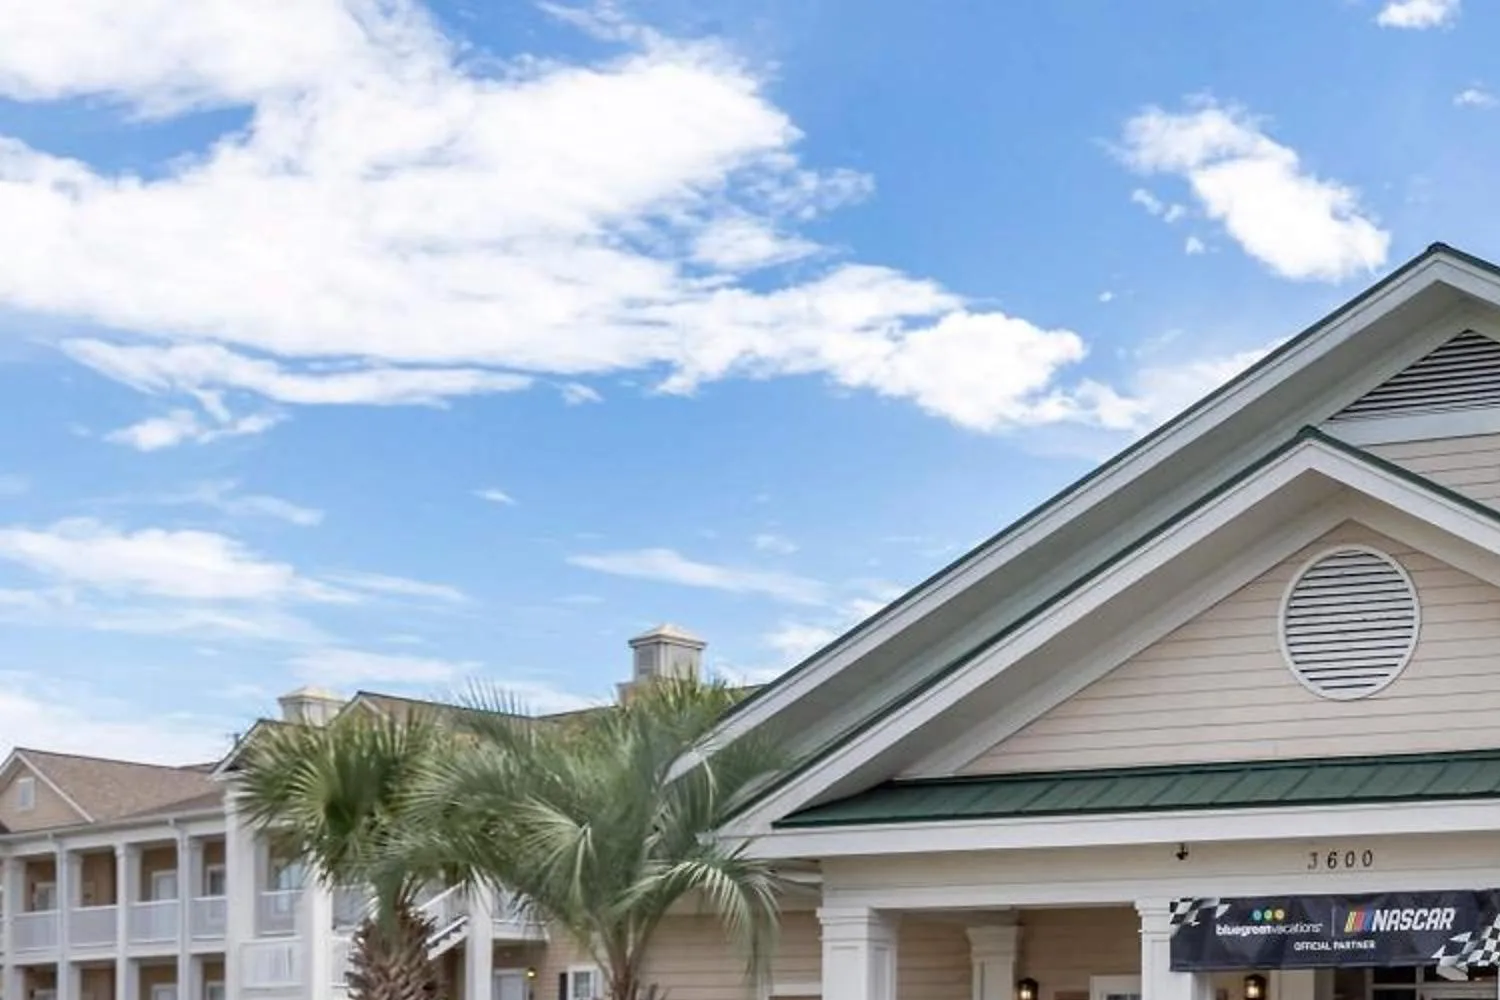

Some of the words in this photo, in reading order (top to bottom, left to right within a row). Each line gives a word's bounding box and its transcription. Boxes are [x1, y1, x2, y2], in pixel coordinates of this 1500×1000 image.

[1307, 849, 1374, 870] 3600
[1371, 907, 1456, 932] NASCAR
[1294, 941, 1331, 952] OFFICIAL
[1334, 939, 1376, 950] PARTNER
